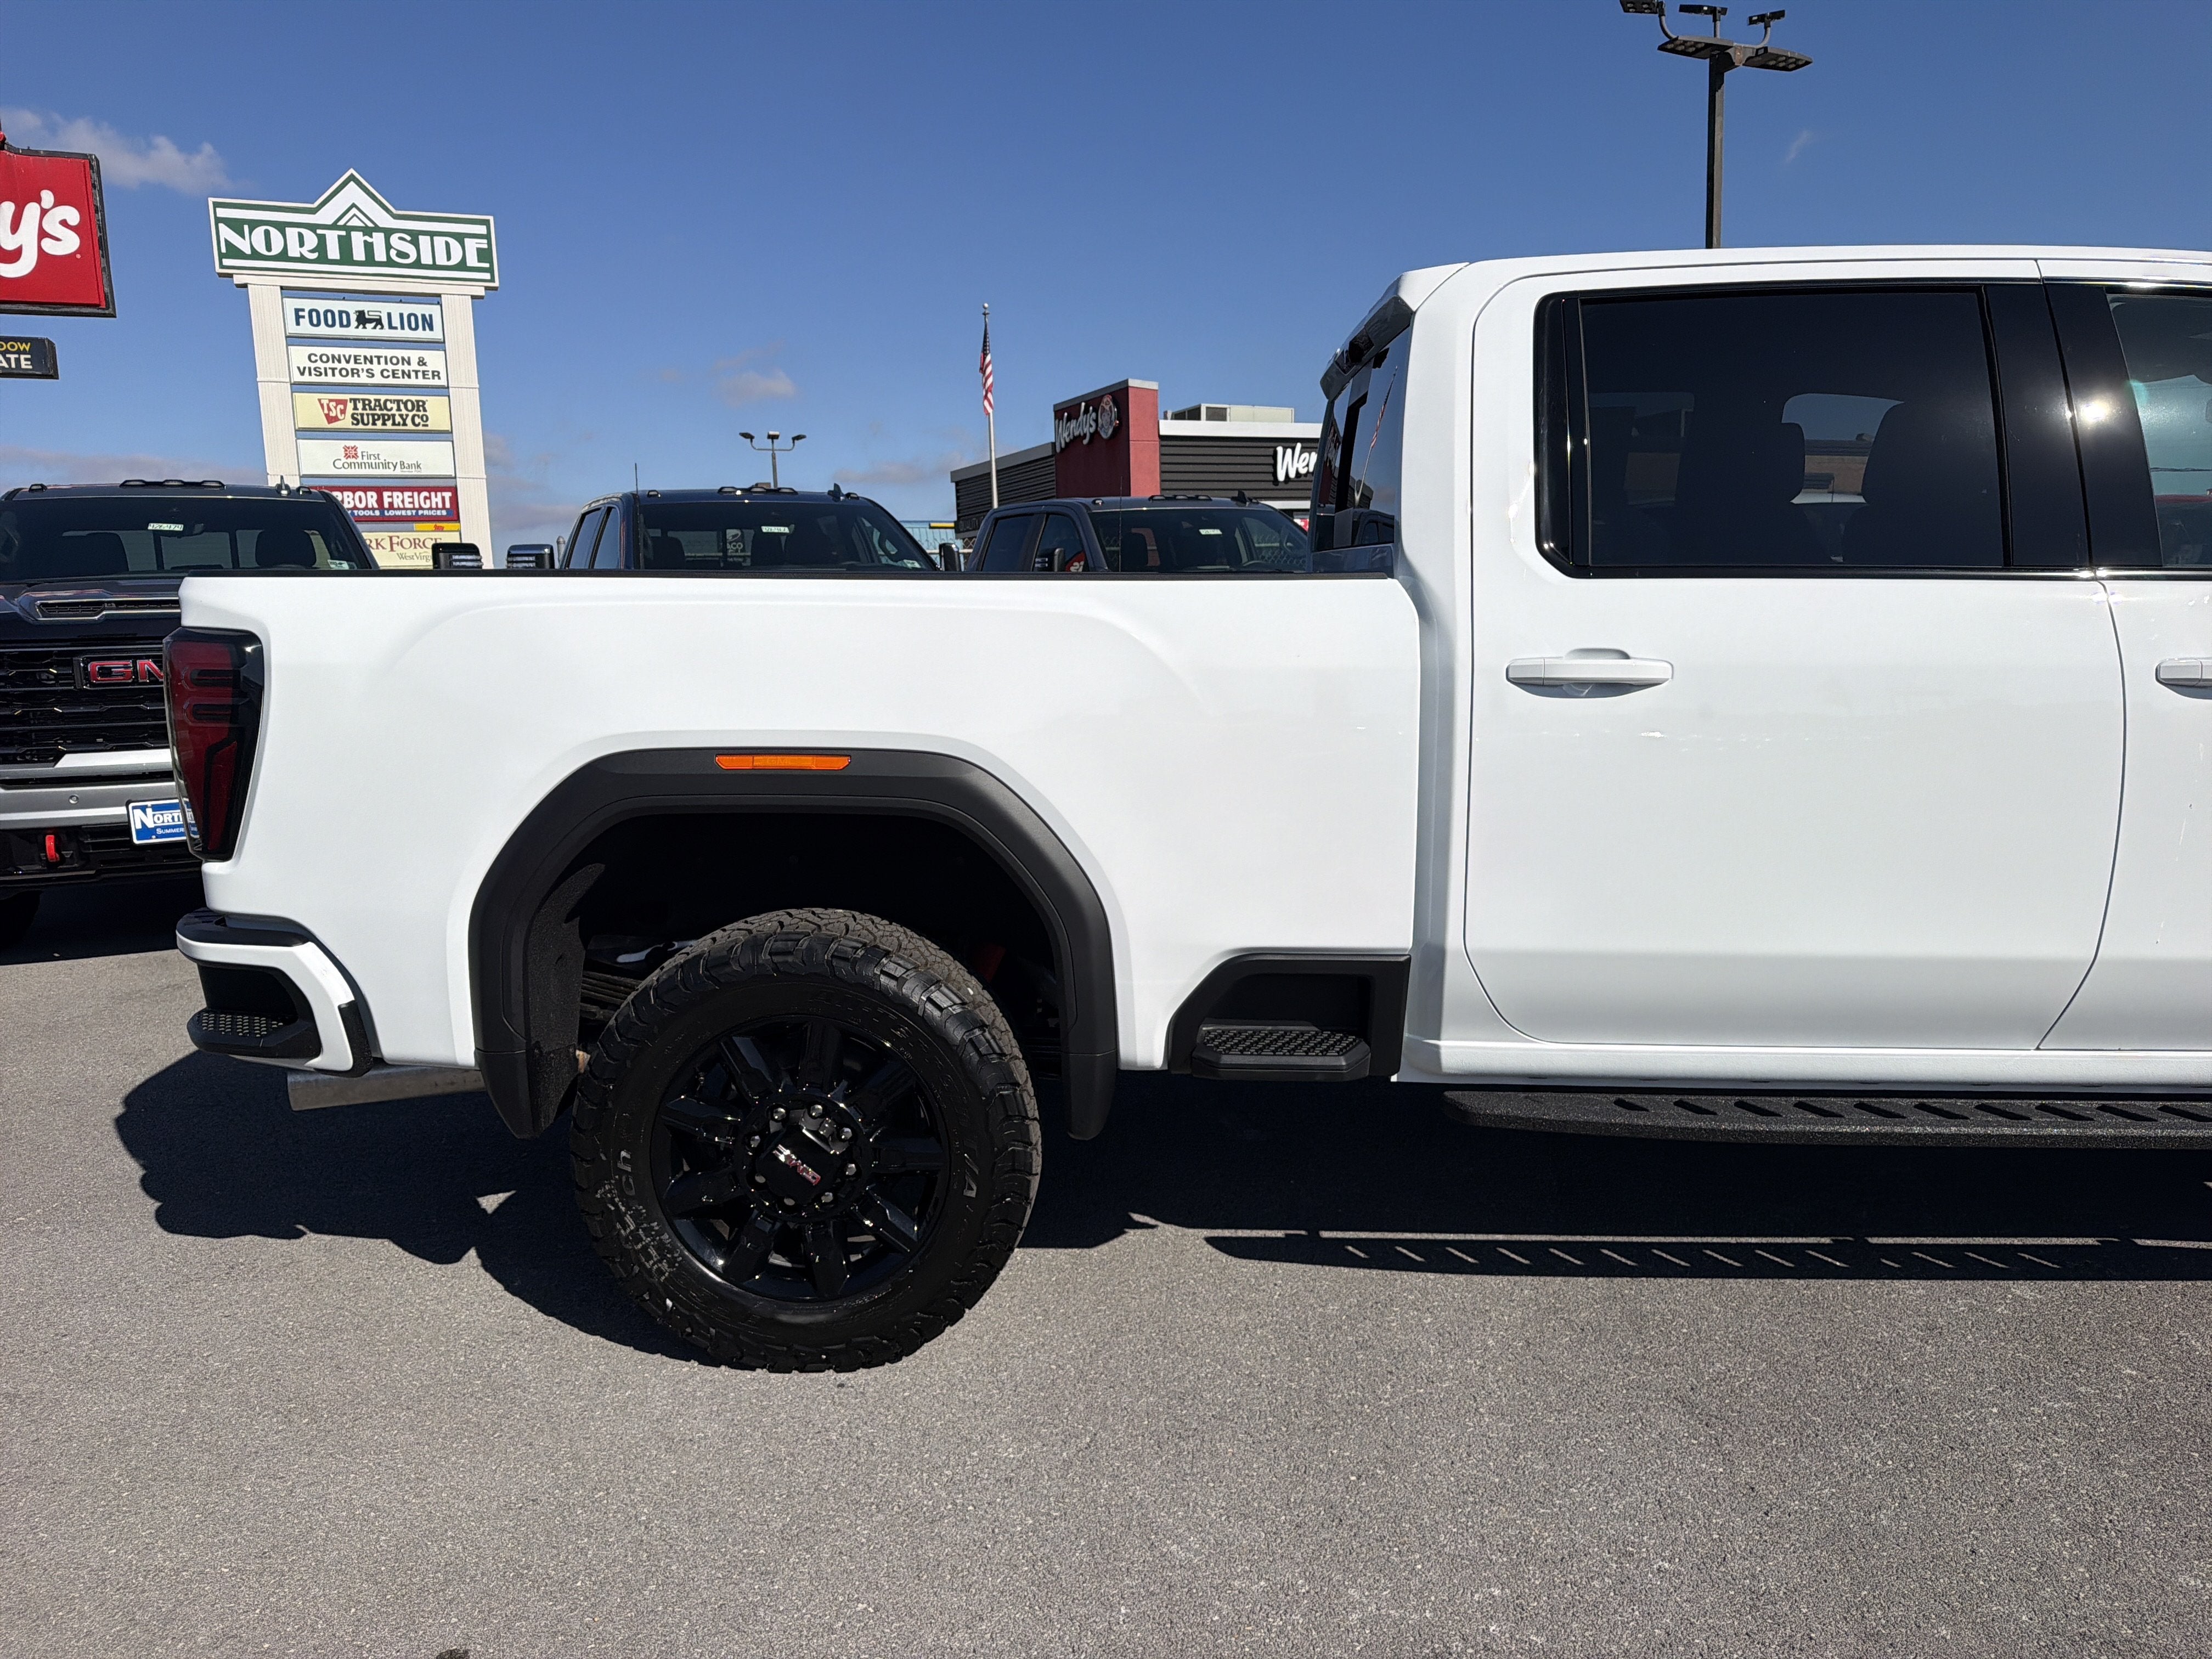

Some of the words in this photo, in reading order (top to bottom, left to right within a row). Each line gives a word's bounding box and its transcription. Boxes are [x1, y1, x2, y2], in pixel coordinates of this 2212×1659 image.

[218, 223, 490, 268] NORTHSIDE
[294, 308, 351, 328] FOOD
[387, 312, 435, 331] LION
[307, 353, 411, 366] CONVENTION
[417, 357, 428, 366] &
[297, 366, 375, 379] VISITOR'S
[380, 367, 441, 380] CENTER
[321, 399, 345, 419] TSC
[349, 398, 427, 412] TRACTOR
[351, 413, 409, 426] SUPPLY
[1056, 402, 1097, 453] Wendy's
[361, 450, 381, 460] First
[332, 458, 398, 472] Community
[399, 460, 422, 470] Bank
[383, 492, 452, 509] FREIGHT
